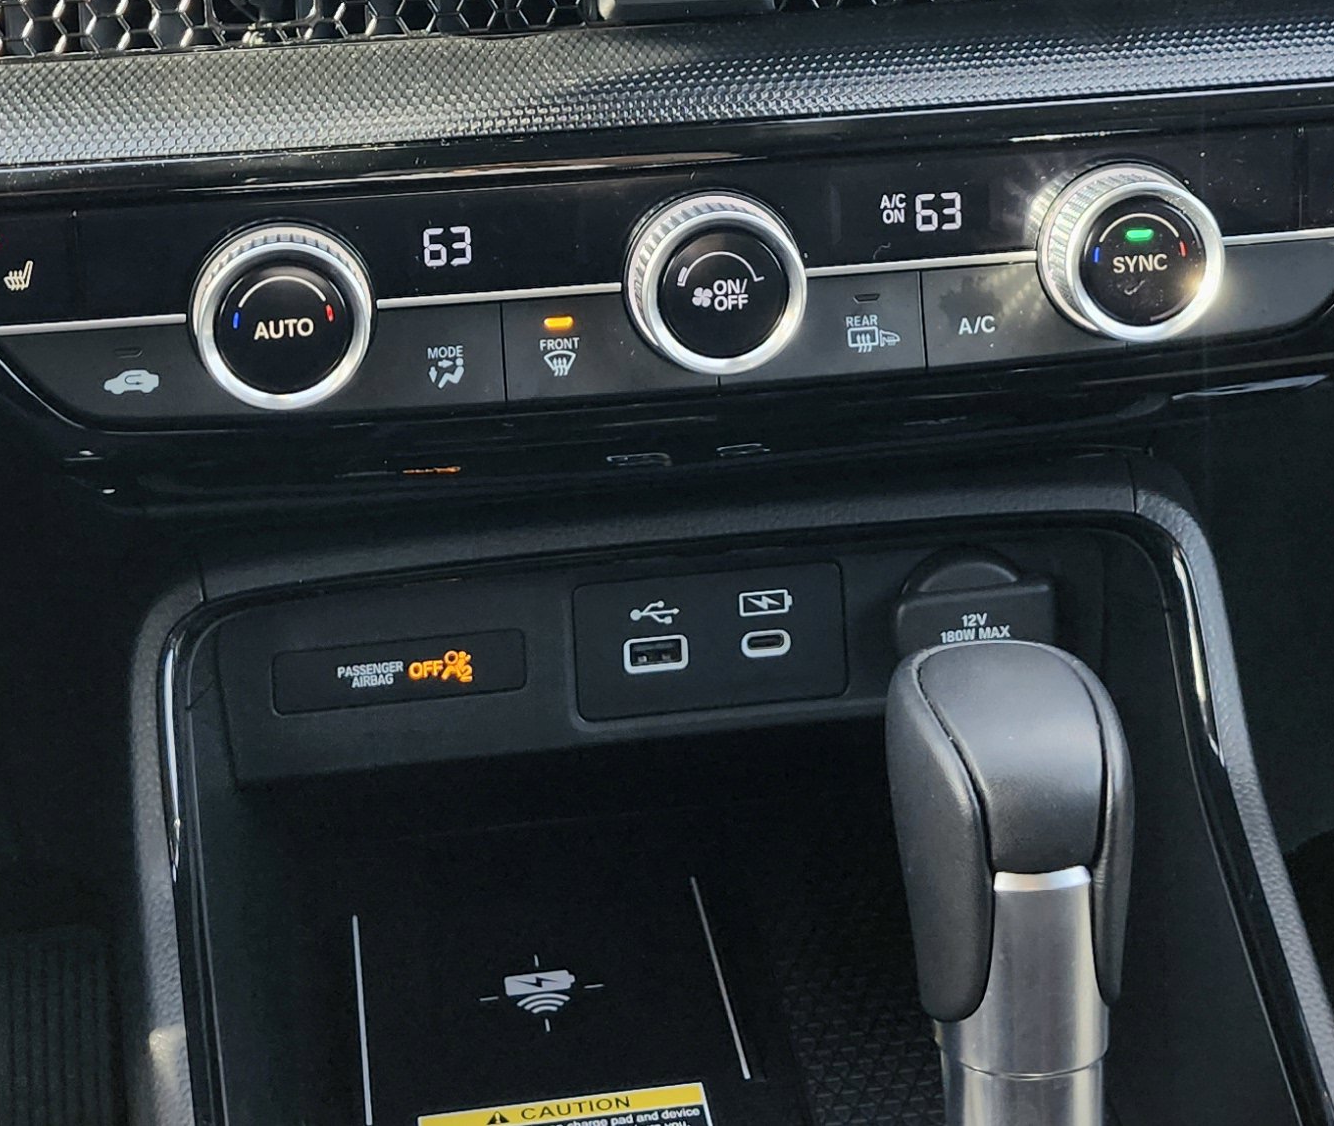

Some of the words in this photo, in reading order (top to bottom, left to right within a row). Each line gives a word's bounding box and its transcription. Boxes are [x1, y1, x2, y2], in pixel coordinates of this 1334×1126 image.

[879, 193, 907, 210] A/C
[882, 208, 906, 224] ON
[915, 191, 963, 232] 63
[423, 225, 472, 267] 63
[1112, 253, 1168, 274] SYNC
[712, 278, 748, 295] ON/
[713, 294, 749, 312] OFF
[253, 316, 314, 340] AUTO
[845, 315, 879, 327] REAR
[958, 315, 996, 335] A/C
[427, 345, 464, 360] MODE
[539, 337, 579, 352] FRONT
[961, 612, 988, 628] 12V
[940, 628, 976, 644] 180W
[978, 624, 1011, 640] MAX
[336, 660, 404, 679] PASSENGER
[407, 659, 444, 681] OFF
[351, 673, 395, 688] AIRBAG
[520, 1095, 631, 1121] CAUTION
[610, 1113, 634, 1126] pad
[636, 1110, 659, 1121] and
[660, 1106, 701, 1120] device
